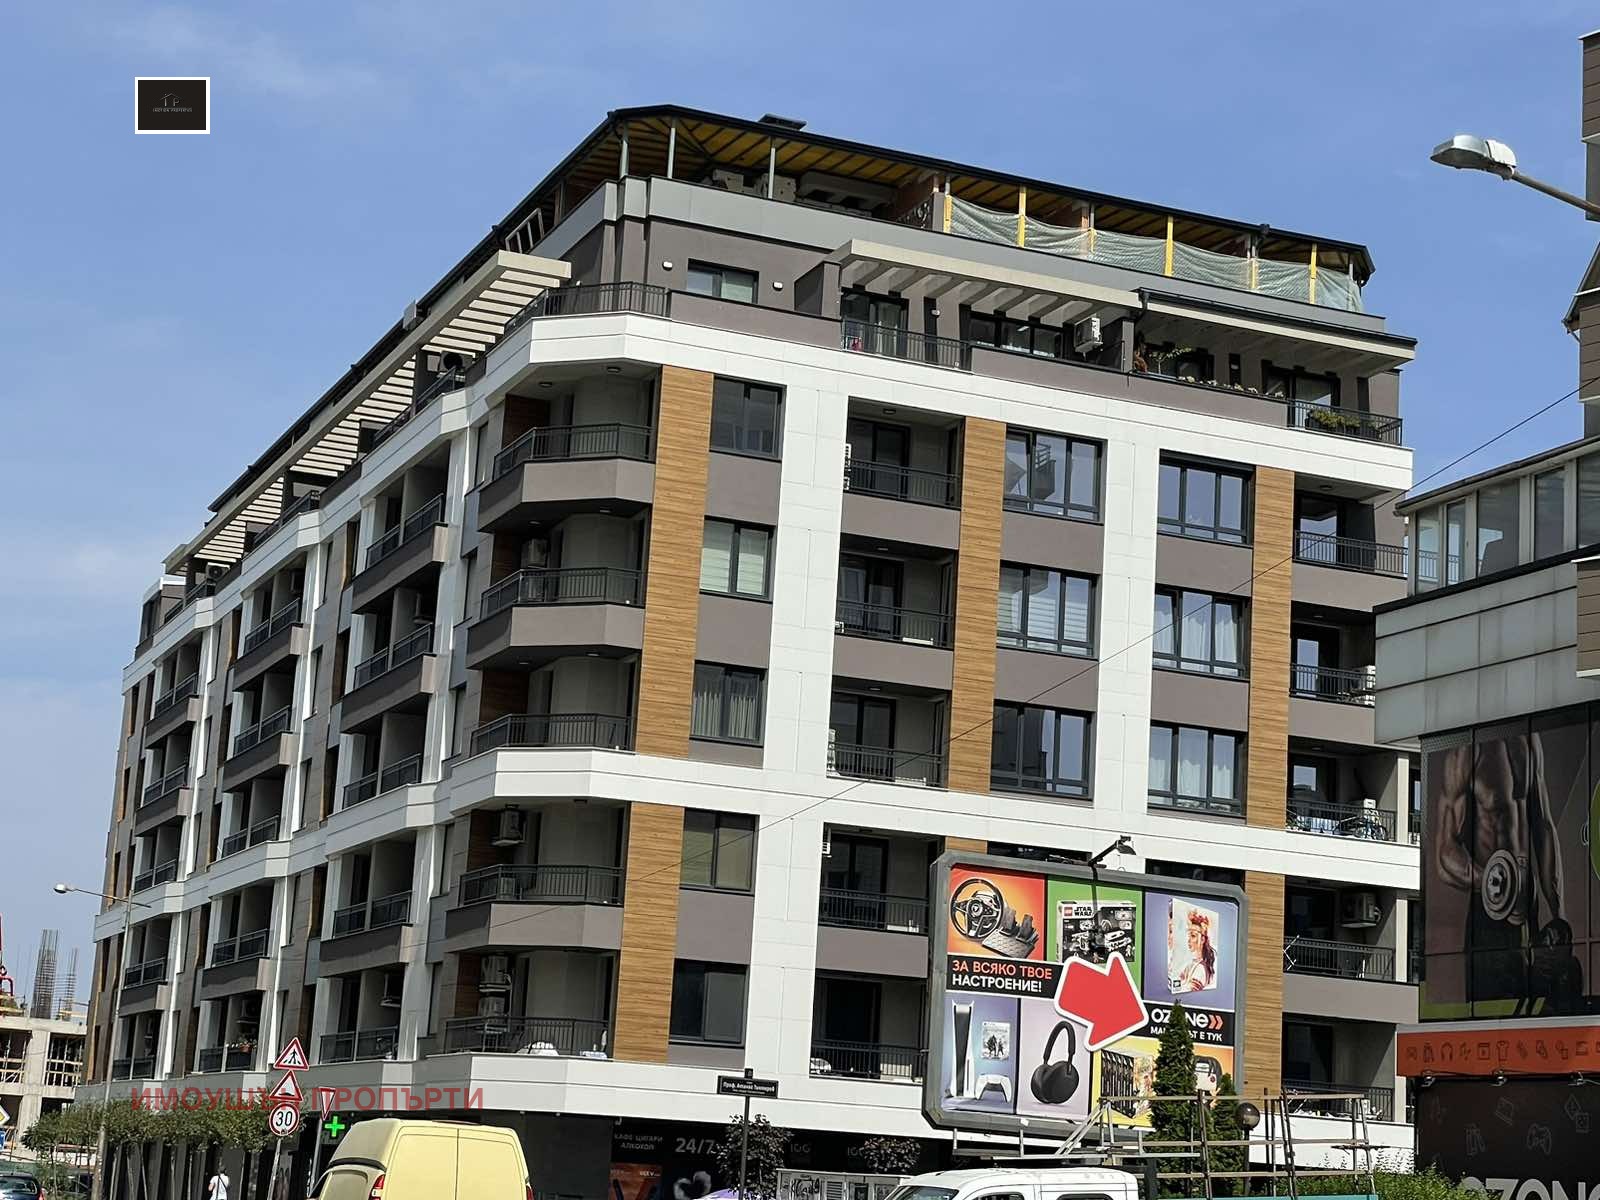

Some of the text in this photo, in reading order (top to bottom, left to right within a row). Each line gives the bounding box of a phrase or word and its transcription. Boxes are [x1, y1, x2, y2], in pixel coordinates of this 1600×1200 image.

[952, 960, 1052, 980] ЗА ВСЯКО ТВОЕ
[952, 973, 1042, 992] НАСТРОЕНИЕ!
[1200, 1031, 1205, 1040] Е
[1206, 1032, 1222, 1042] ТУК
[276, 1111, 293, 1127] 30
[675, 1137, 715, 1155] 24/7
